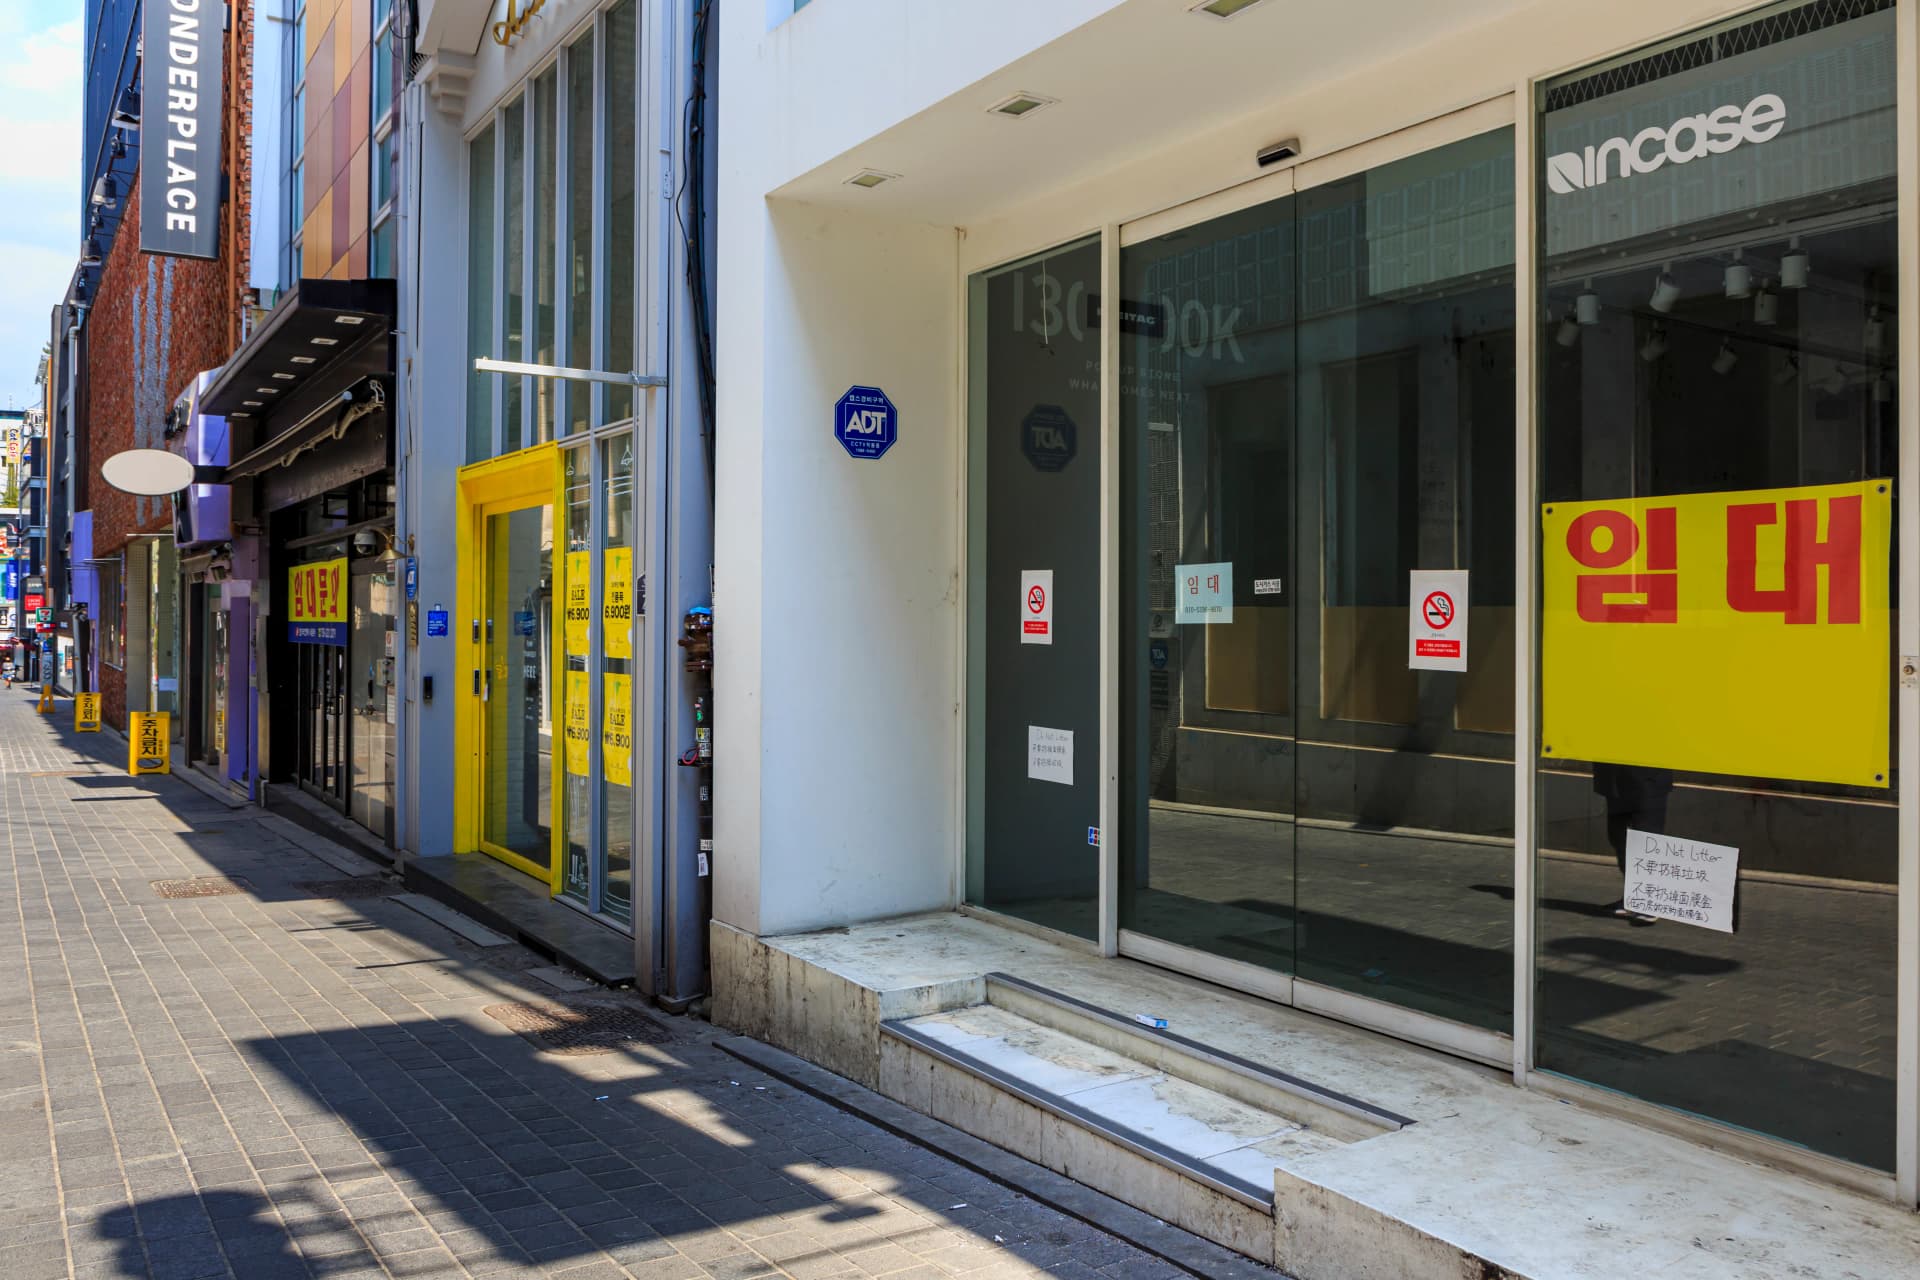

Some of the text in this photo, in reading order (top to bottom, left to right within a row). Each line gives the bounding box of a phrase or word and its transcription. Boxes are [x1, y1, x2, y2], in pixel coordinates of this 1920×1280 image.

[1584, 94, 1787, 188] incase
[846, 410, 887, 435] ADT
[294, 564, 340, 618] 임대문의
[141, 719, 159, 755] 주차금지
[1645, 836, 1723, 863] Do Not Litter
